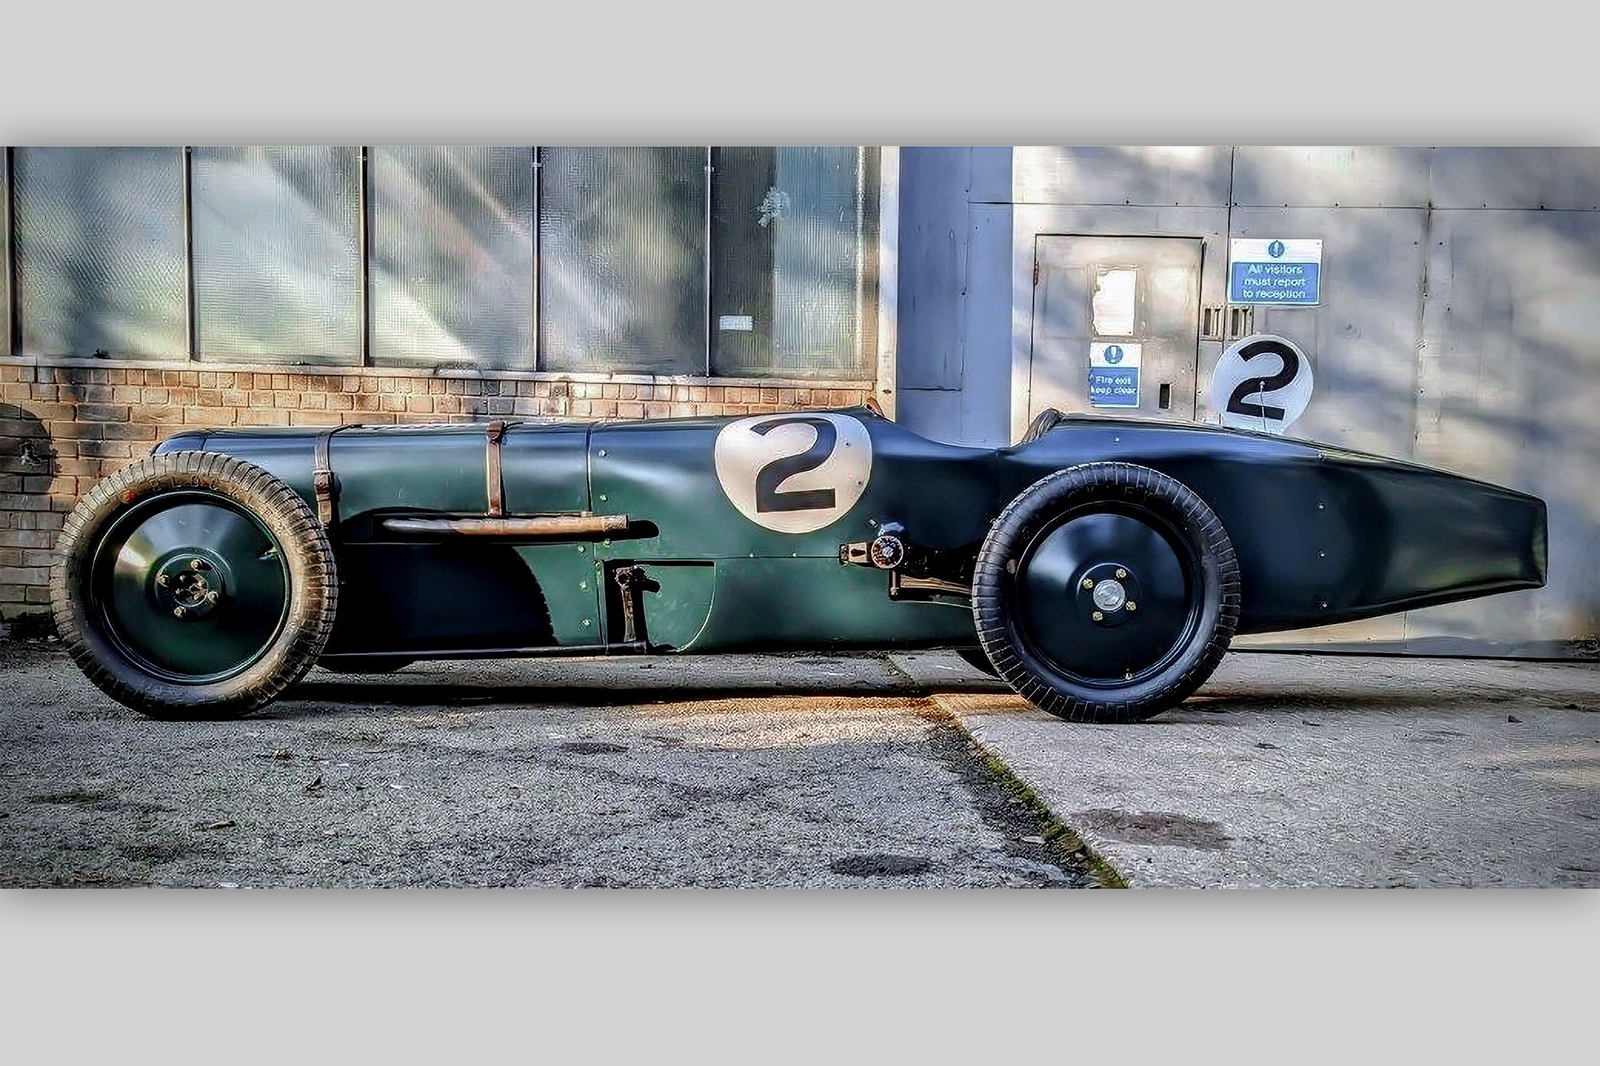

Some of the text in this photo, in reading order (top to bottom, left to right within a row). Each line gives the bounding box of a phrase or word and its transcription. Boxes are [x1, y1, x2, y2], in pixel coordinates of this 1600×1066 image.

[1248, 264, 1304, 274] All visitors
[1244, 277, 1306, 287] must report
[1243, 288, 1306, 299] to reception
[1226, 340, 1299, 421] 2
[750, 417, 837, 514] 2
